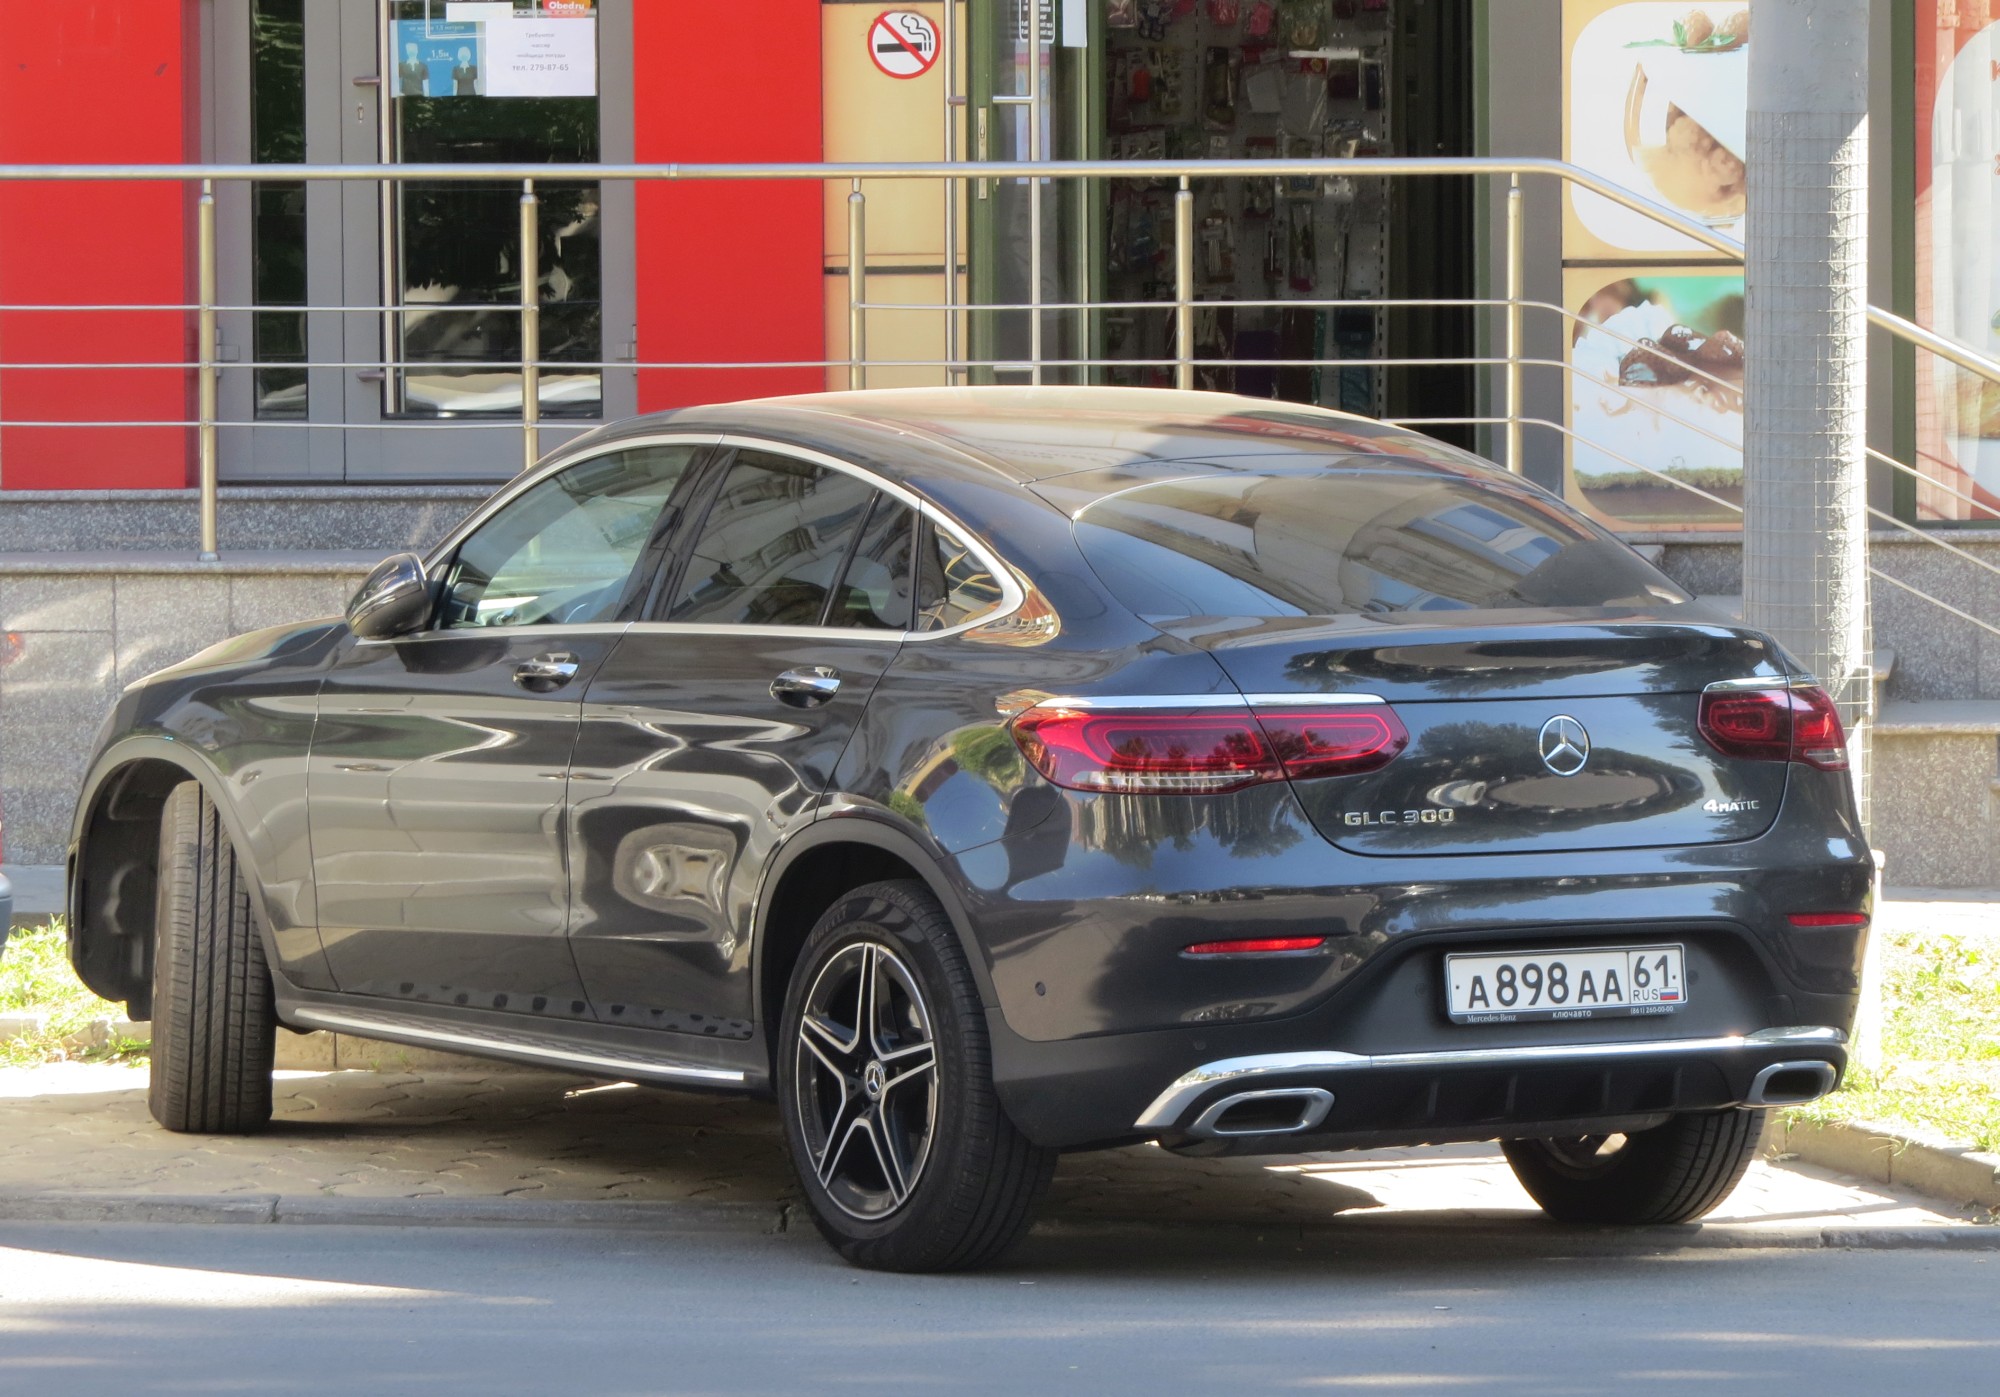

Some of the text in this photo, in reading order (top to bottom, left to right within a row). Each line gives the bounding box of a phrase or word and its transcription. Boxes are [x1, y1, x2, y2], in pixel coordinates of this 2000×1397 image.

[529, 63, 569, 71] 279-87-65
[1703, 799, 1760, 813] 4MATIC
[1344, 808, 1455, 826] GLC 300
[1633, 954, 1669, 988] 61
[1632, 988, 1659, 1002] RUS
[1466, 1013, 1517, 1024] Mercedes-Benz
